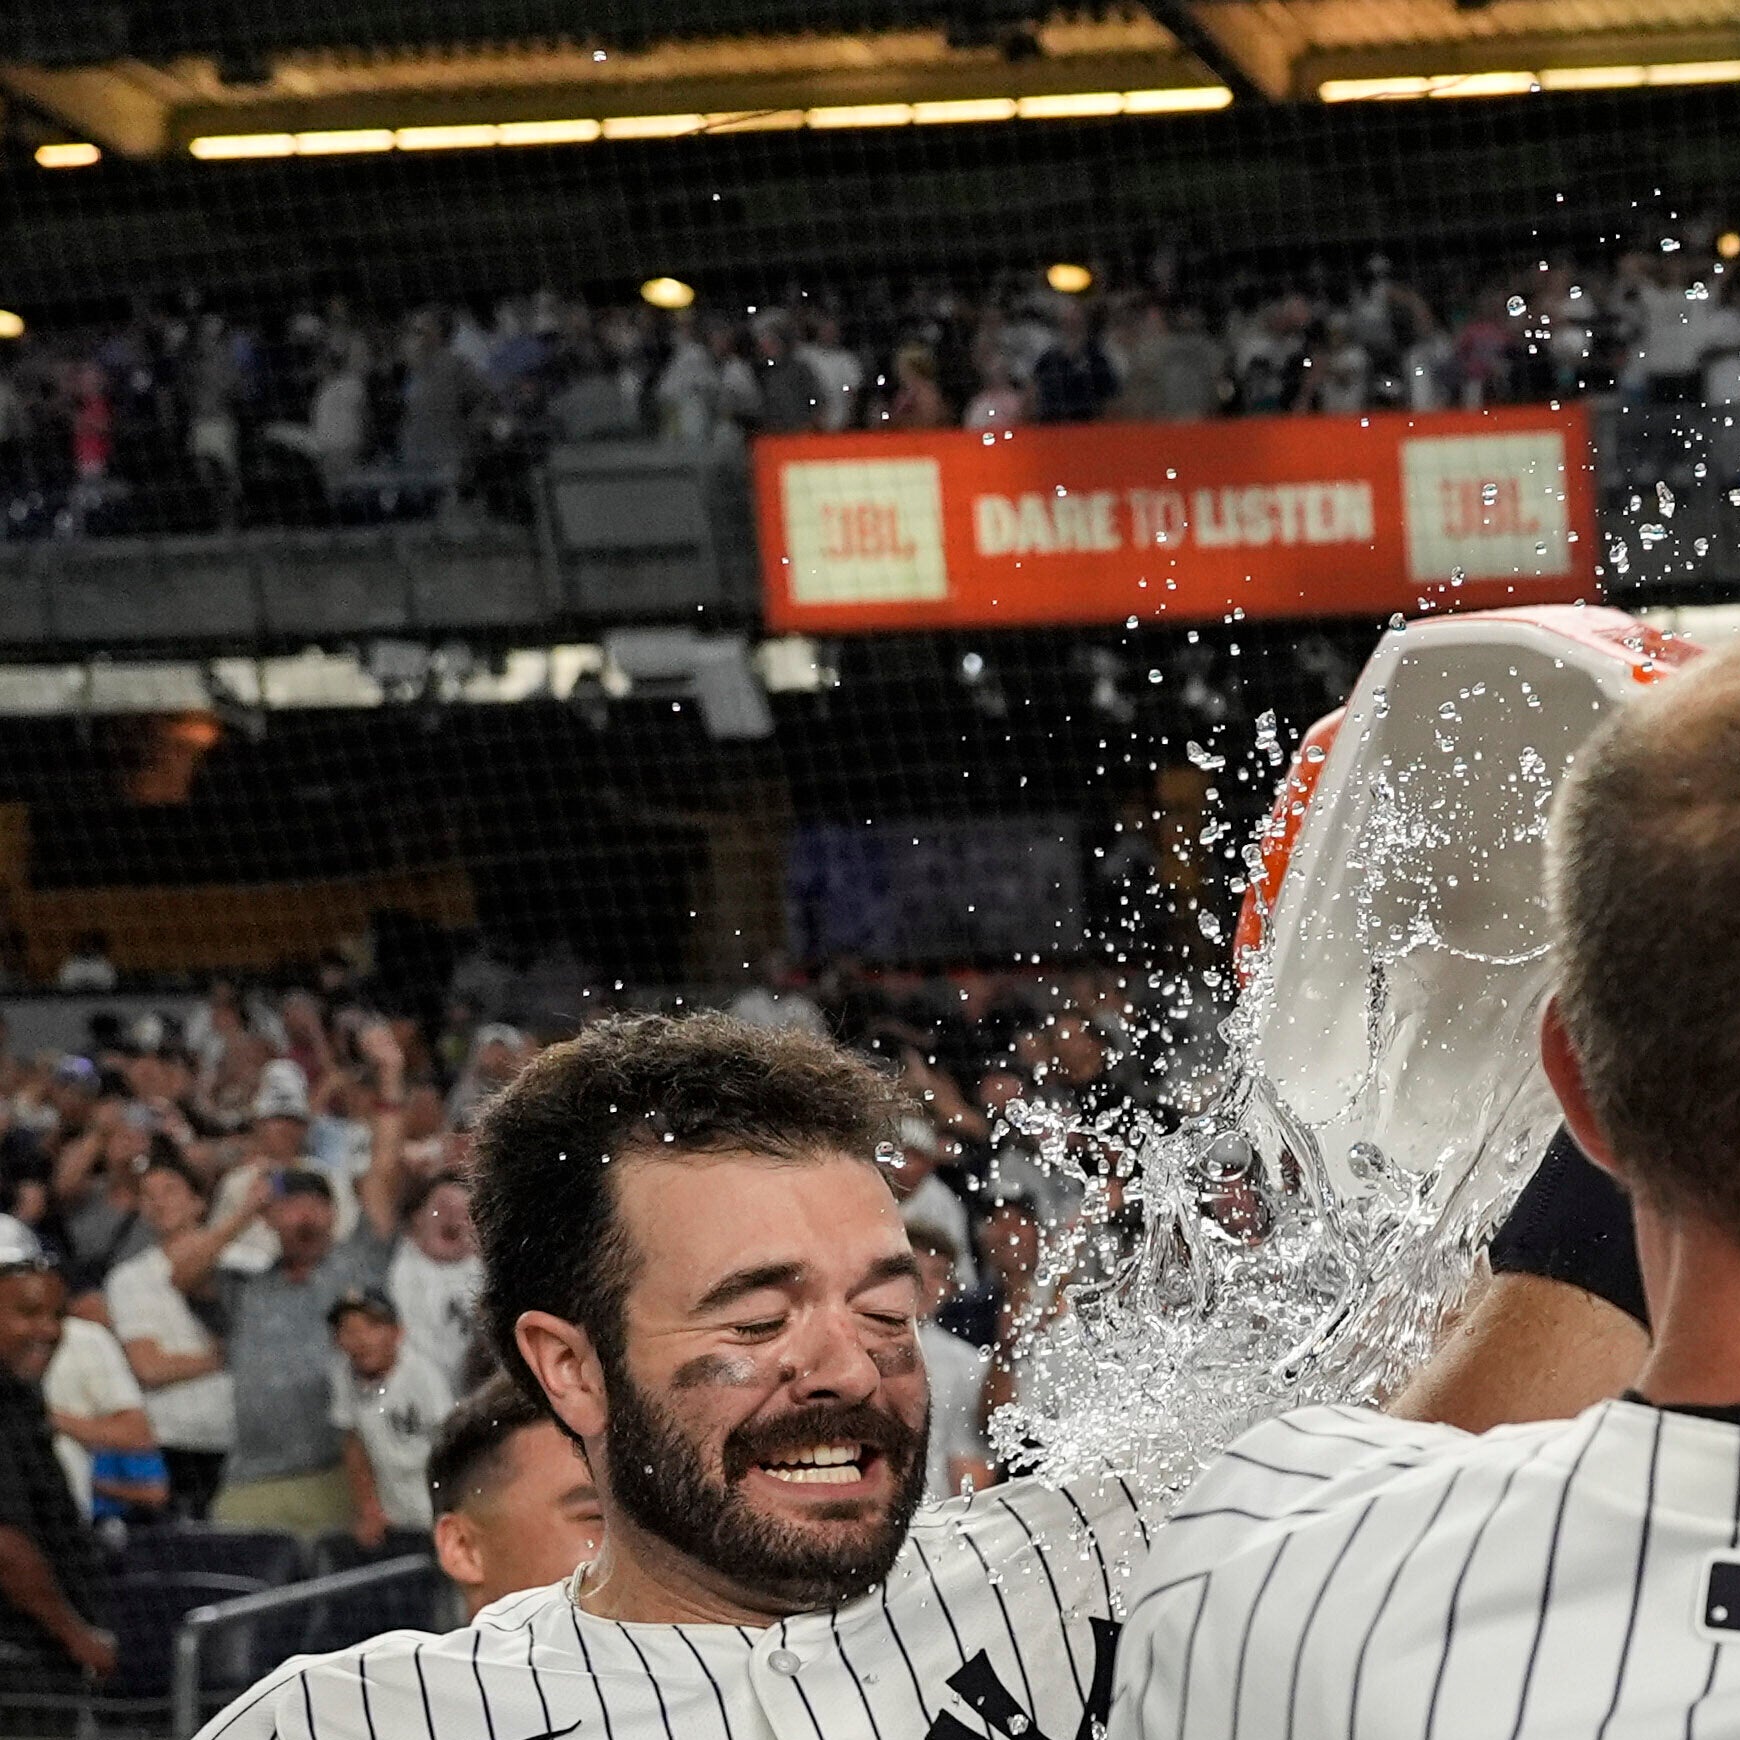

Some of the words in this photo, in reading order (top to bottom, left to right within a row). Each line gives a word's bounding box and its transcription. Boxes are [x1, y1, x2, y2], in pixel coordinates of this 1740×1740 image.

[820, 500, 917, 562] JBL
[973, 491, 1122, 555] DARE
[1126, 487, 1187, 550] TO
[1193, 479, 1376, 550] LISTEN
